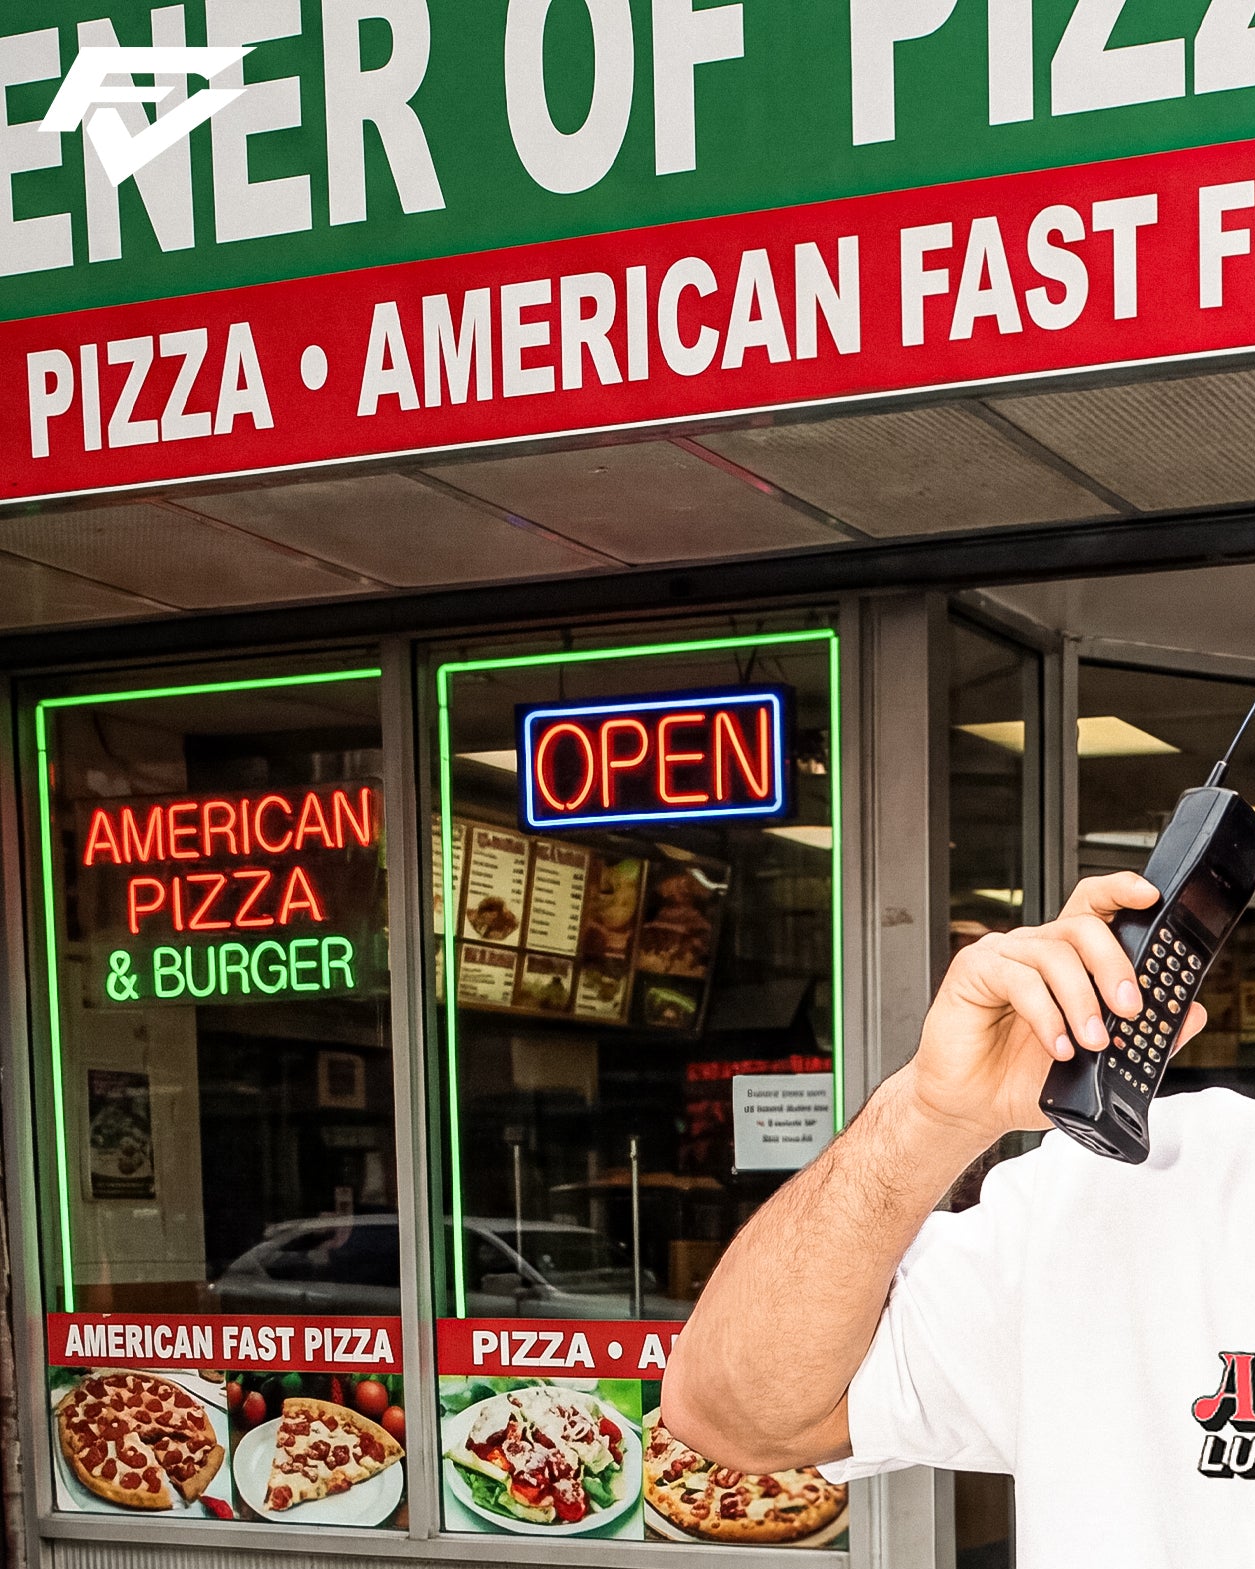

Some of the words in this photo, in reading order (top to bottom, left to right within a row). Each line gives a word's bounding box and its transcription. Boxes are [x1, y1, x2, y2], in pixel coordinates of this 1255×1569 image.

[504, 0, 746, 195] OF
[26, 322, 275, 459] PIZZA
[356, 235, 861, 418] AMERICAN
[900, 193, 1158, 347] FAST
[534, 706, 771, 811] OPEN
[83, 786, 374, 866] AMERICAN
[127, 865, 325, 935] PIZZA
[105, 949, 140, 1001] &
[152, 935, 356, 998] BURGER
[64, 1323, 214, 1360] AMERICAN
[221, 1326, 295, 1361] FAST
[303, 1327, 395, 1364] PIZZA
[472, 1329, 596, 1369] PIZZA
